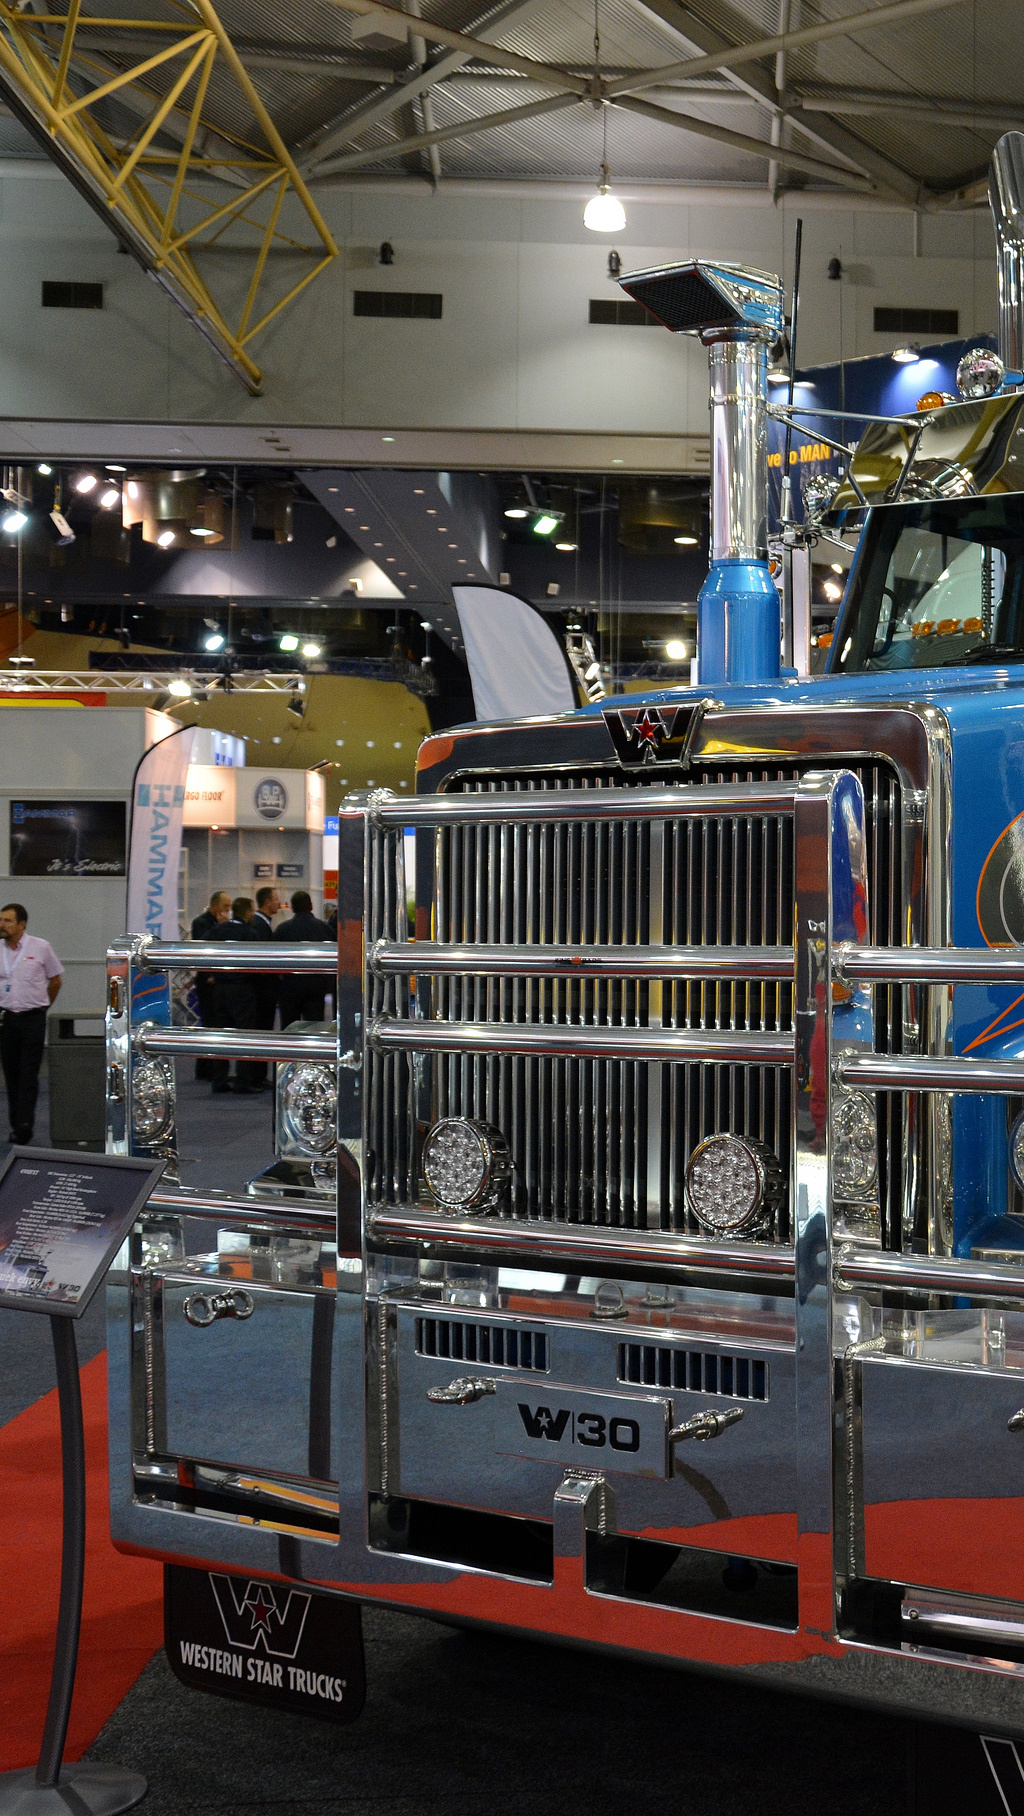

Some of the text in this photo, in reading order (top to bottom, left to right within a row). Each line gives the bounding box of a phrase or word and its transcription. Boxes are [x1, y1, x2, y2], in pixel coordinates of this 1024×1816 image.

[767, 453, 782, 467] ve
[800, 443, 831, 463] MAN
[180, 1640, 345, 1702] WESTERN STAR TRUCKS
